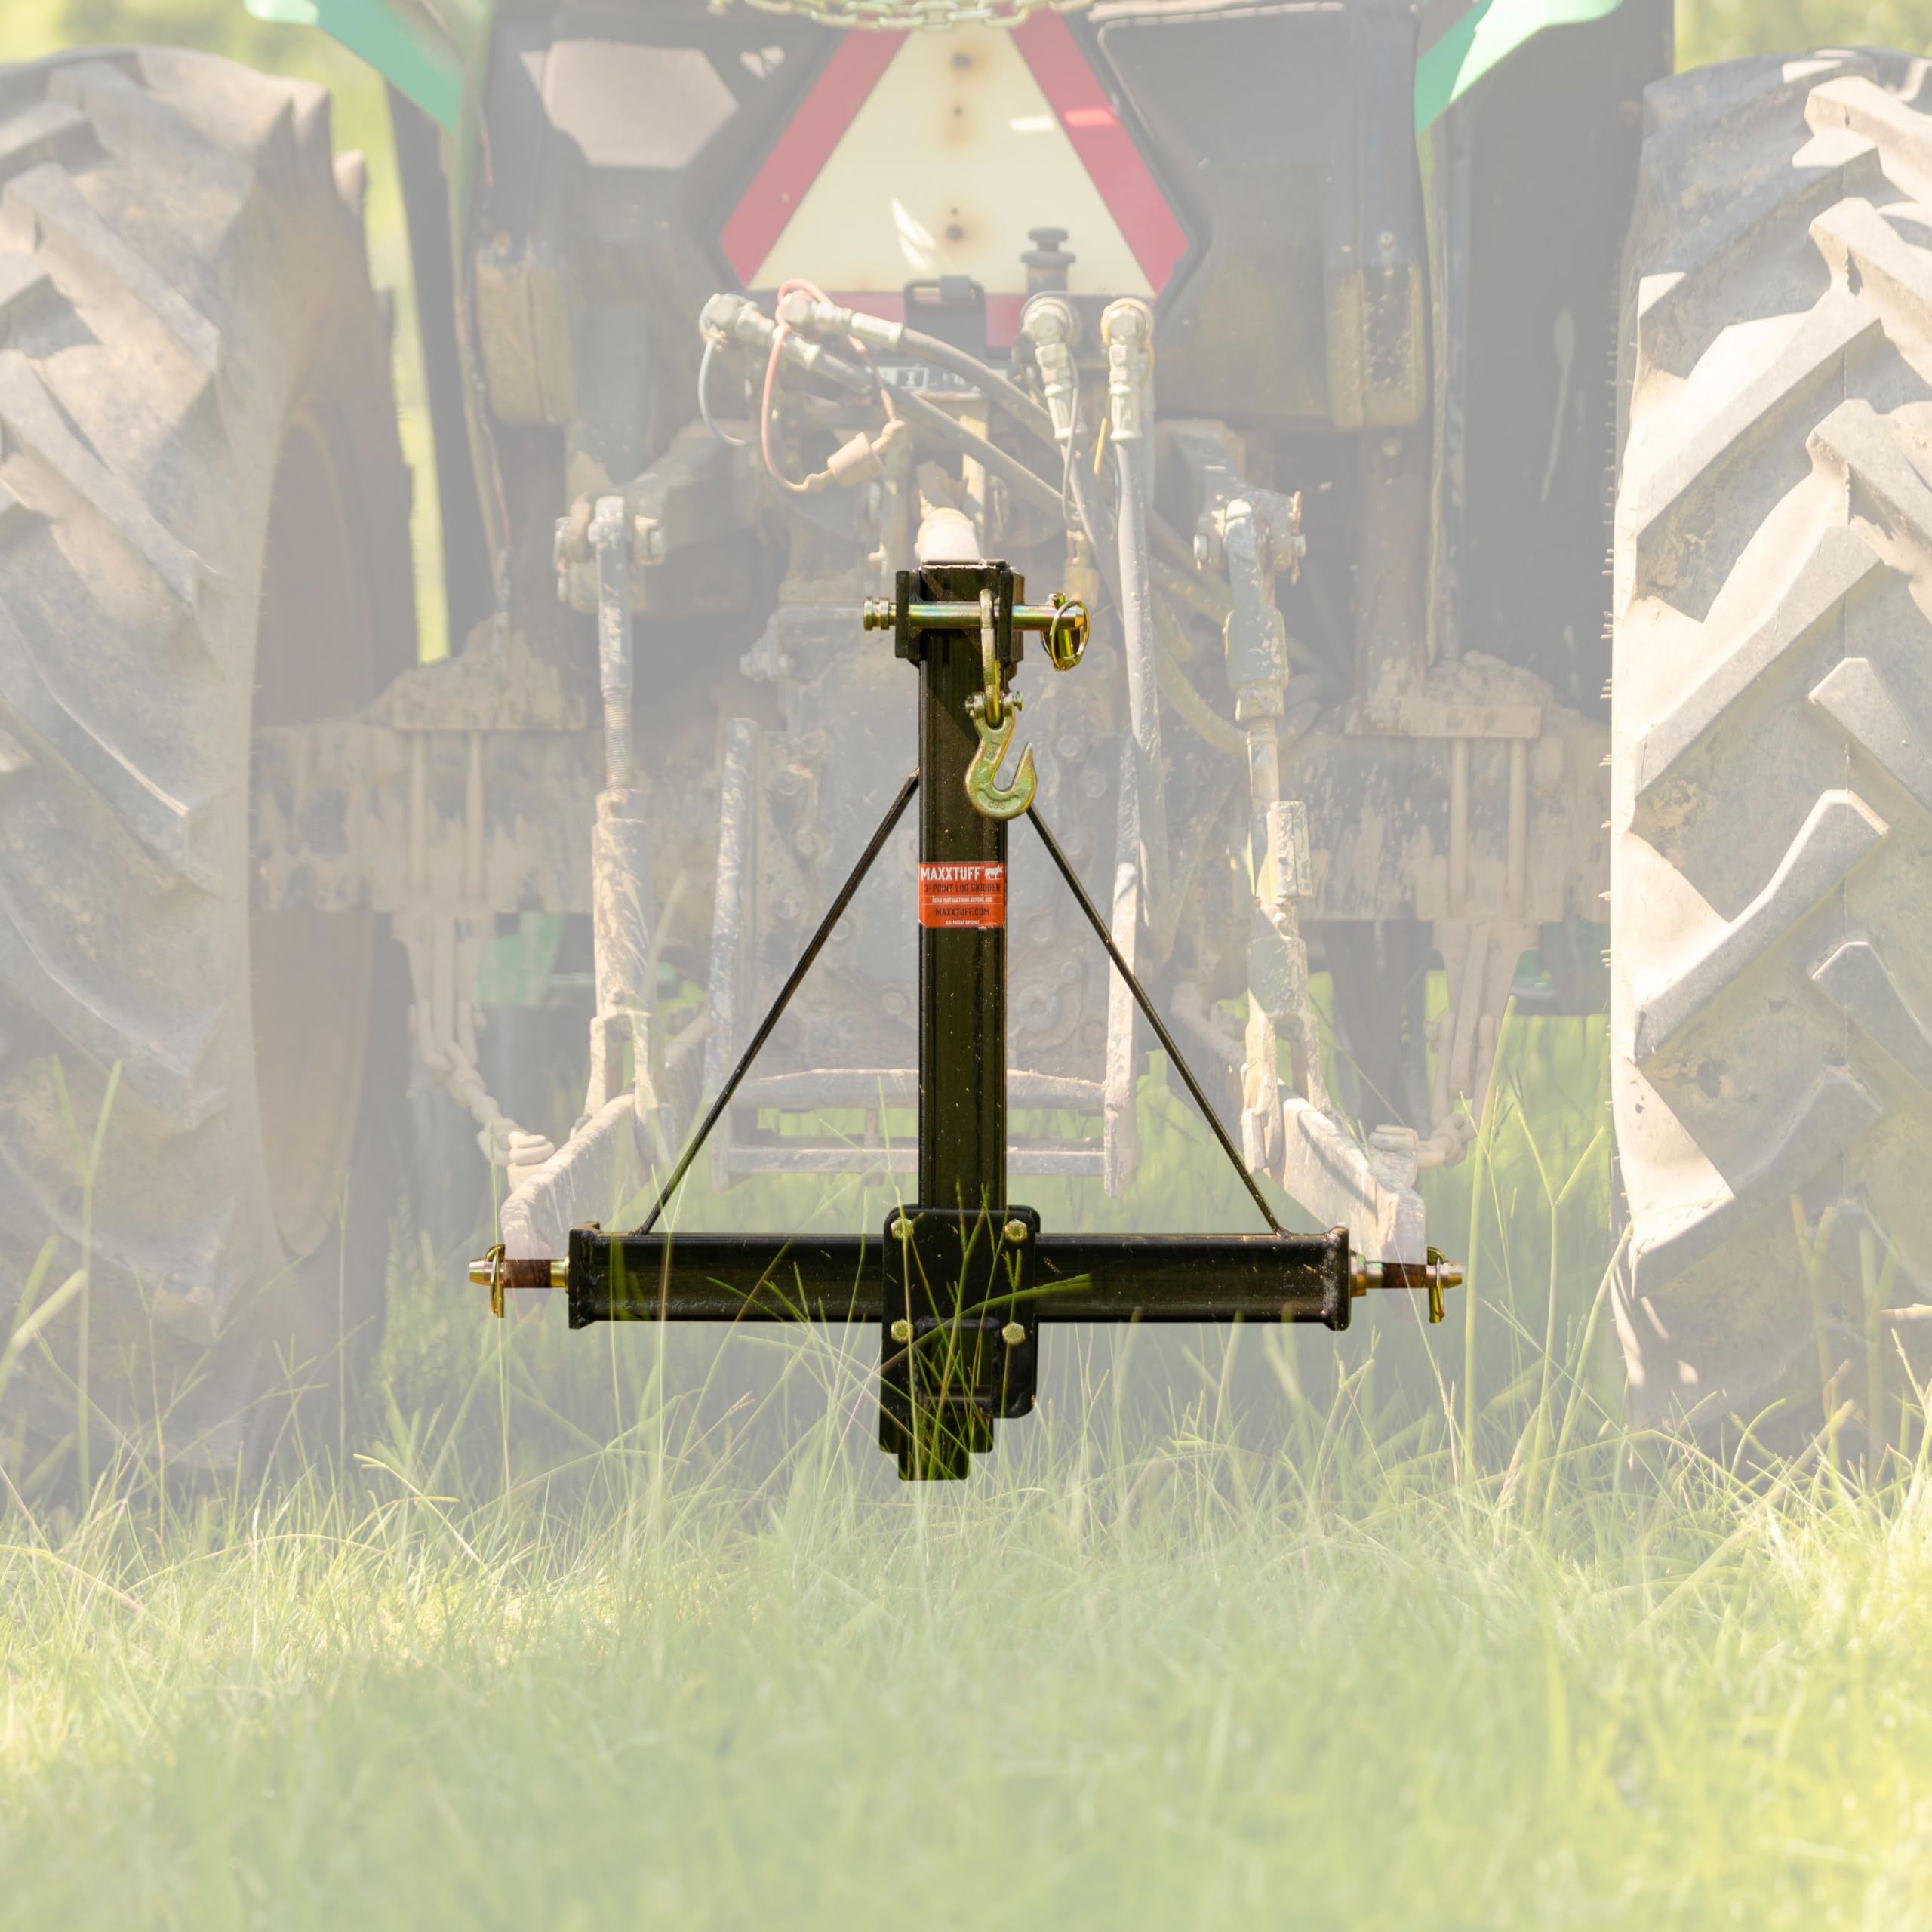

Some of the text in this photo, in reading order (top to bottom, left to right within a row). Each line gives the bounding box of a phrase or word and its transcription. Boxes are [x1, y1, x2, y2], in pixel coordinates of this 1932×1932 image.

[921, 866, 981, 881] MAXXTUFF
[924, 884, 1001, 894] 3-POINT LOG SKIDDER
[935, 908, 990, 916] MAXXTUFF.COM
